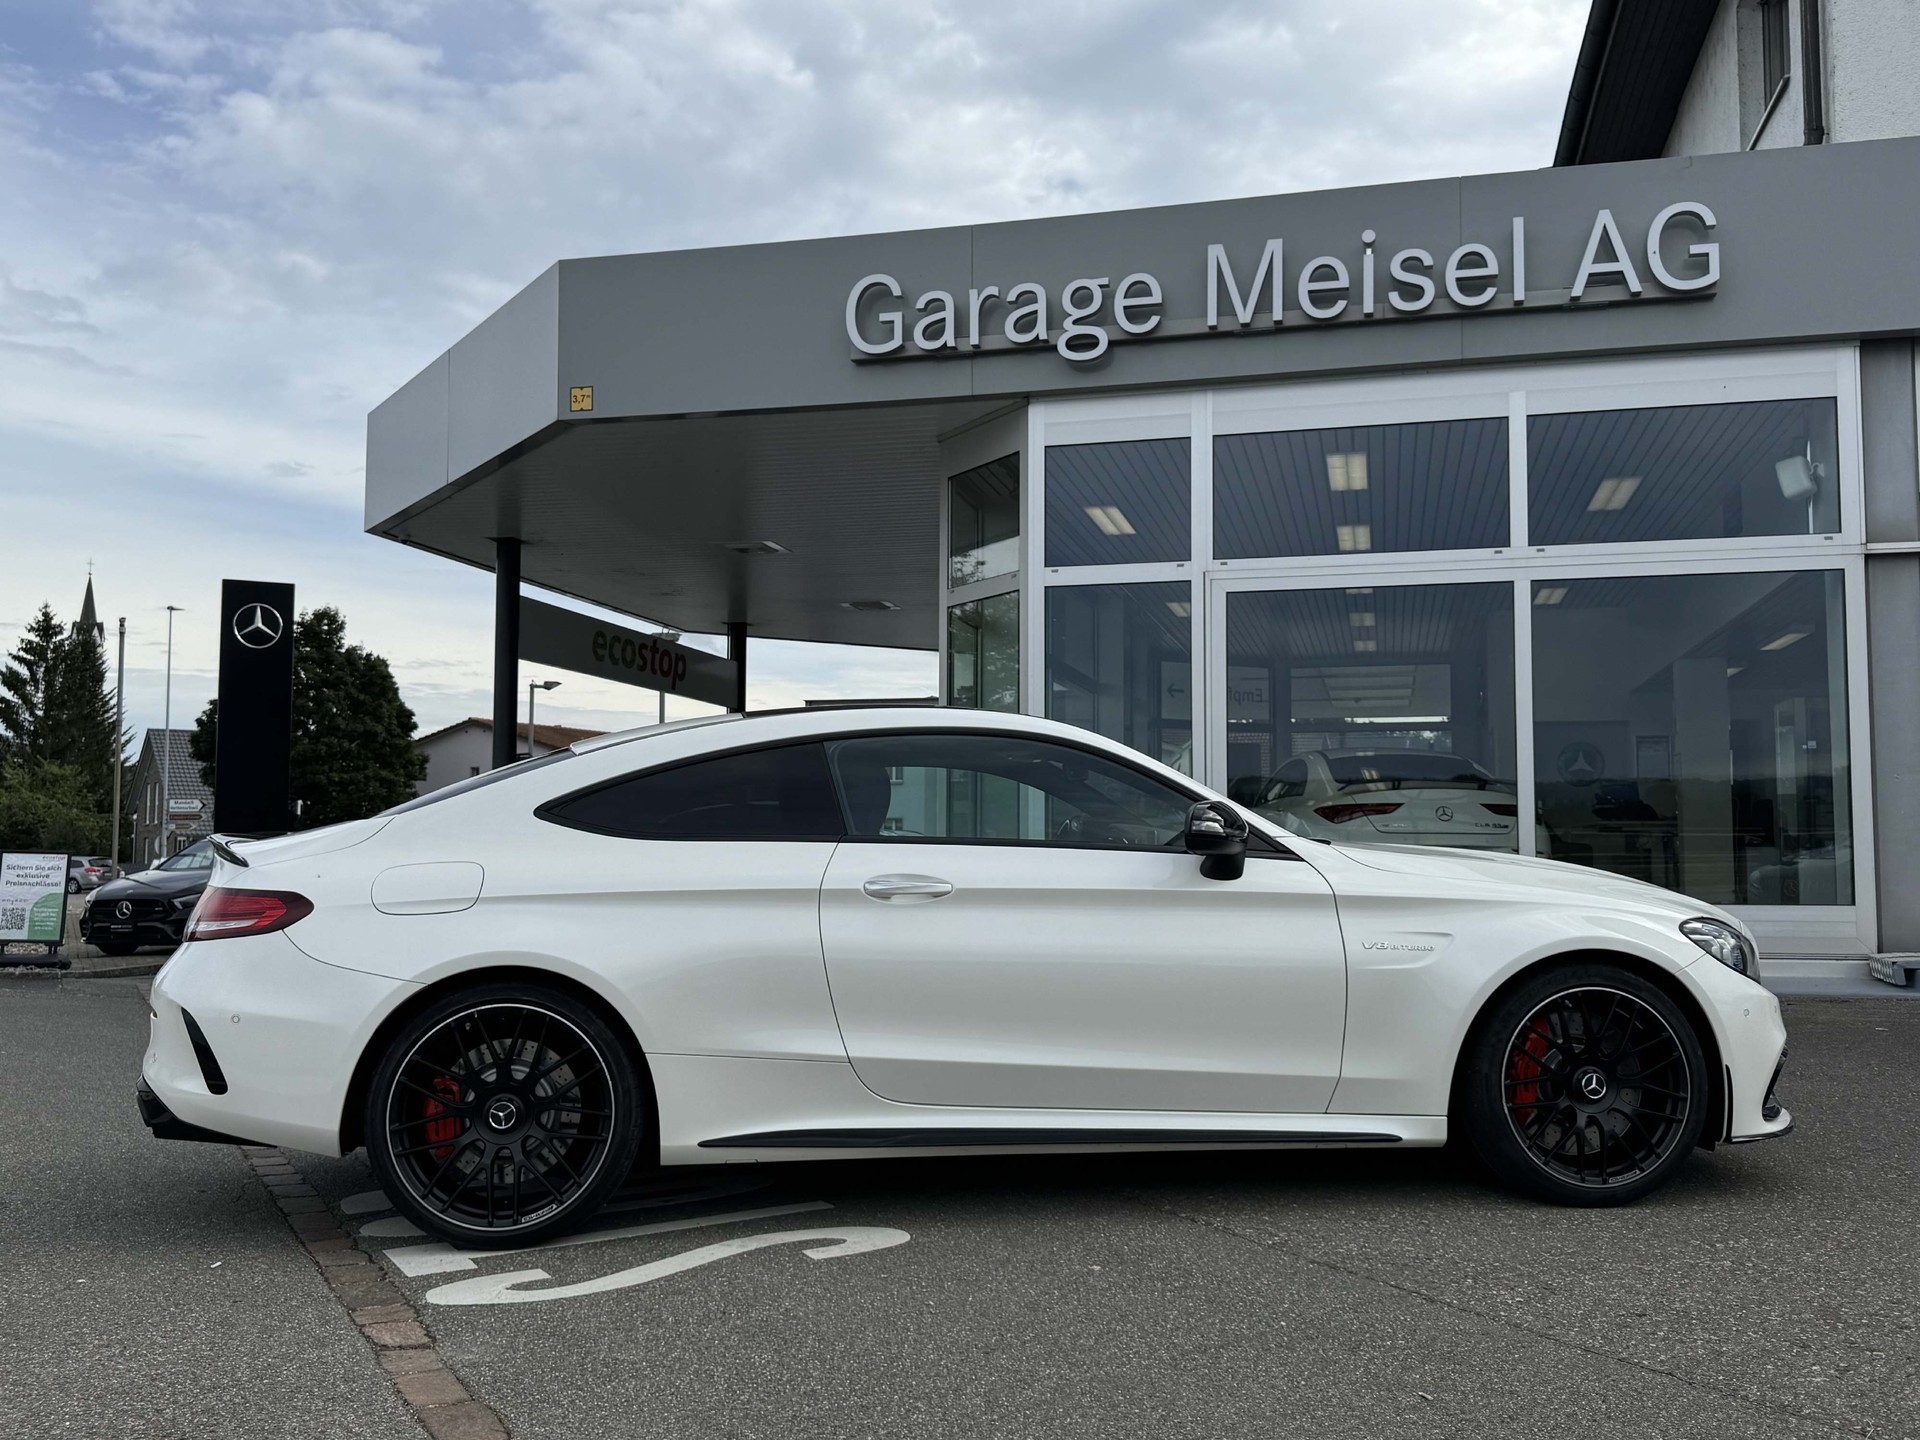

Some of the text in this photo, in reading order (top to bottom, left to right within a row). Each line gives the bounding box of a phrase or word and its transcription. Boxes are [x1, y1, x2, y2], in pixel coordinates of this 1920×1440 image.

[845, 201, 1721, 362] Garage Meisel AG
[592, 630, 687, 691] ecostop
[1362, 941, 1435, 952] V8 BITURBO
